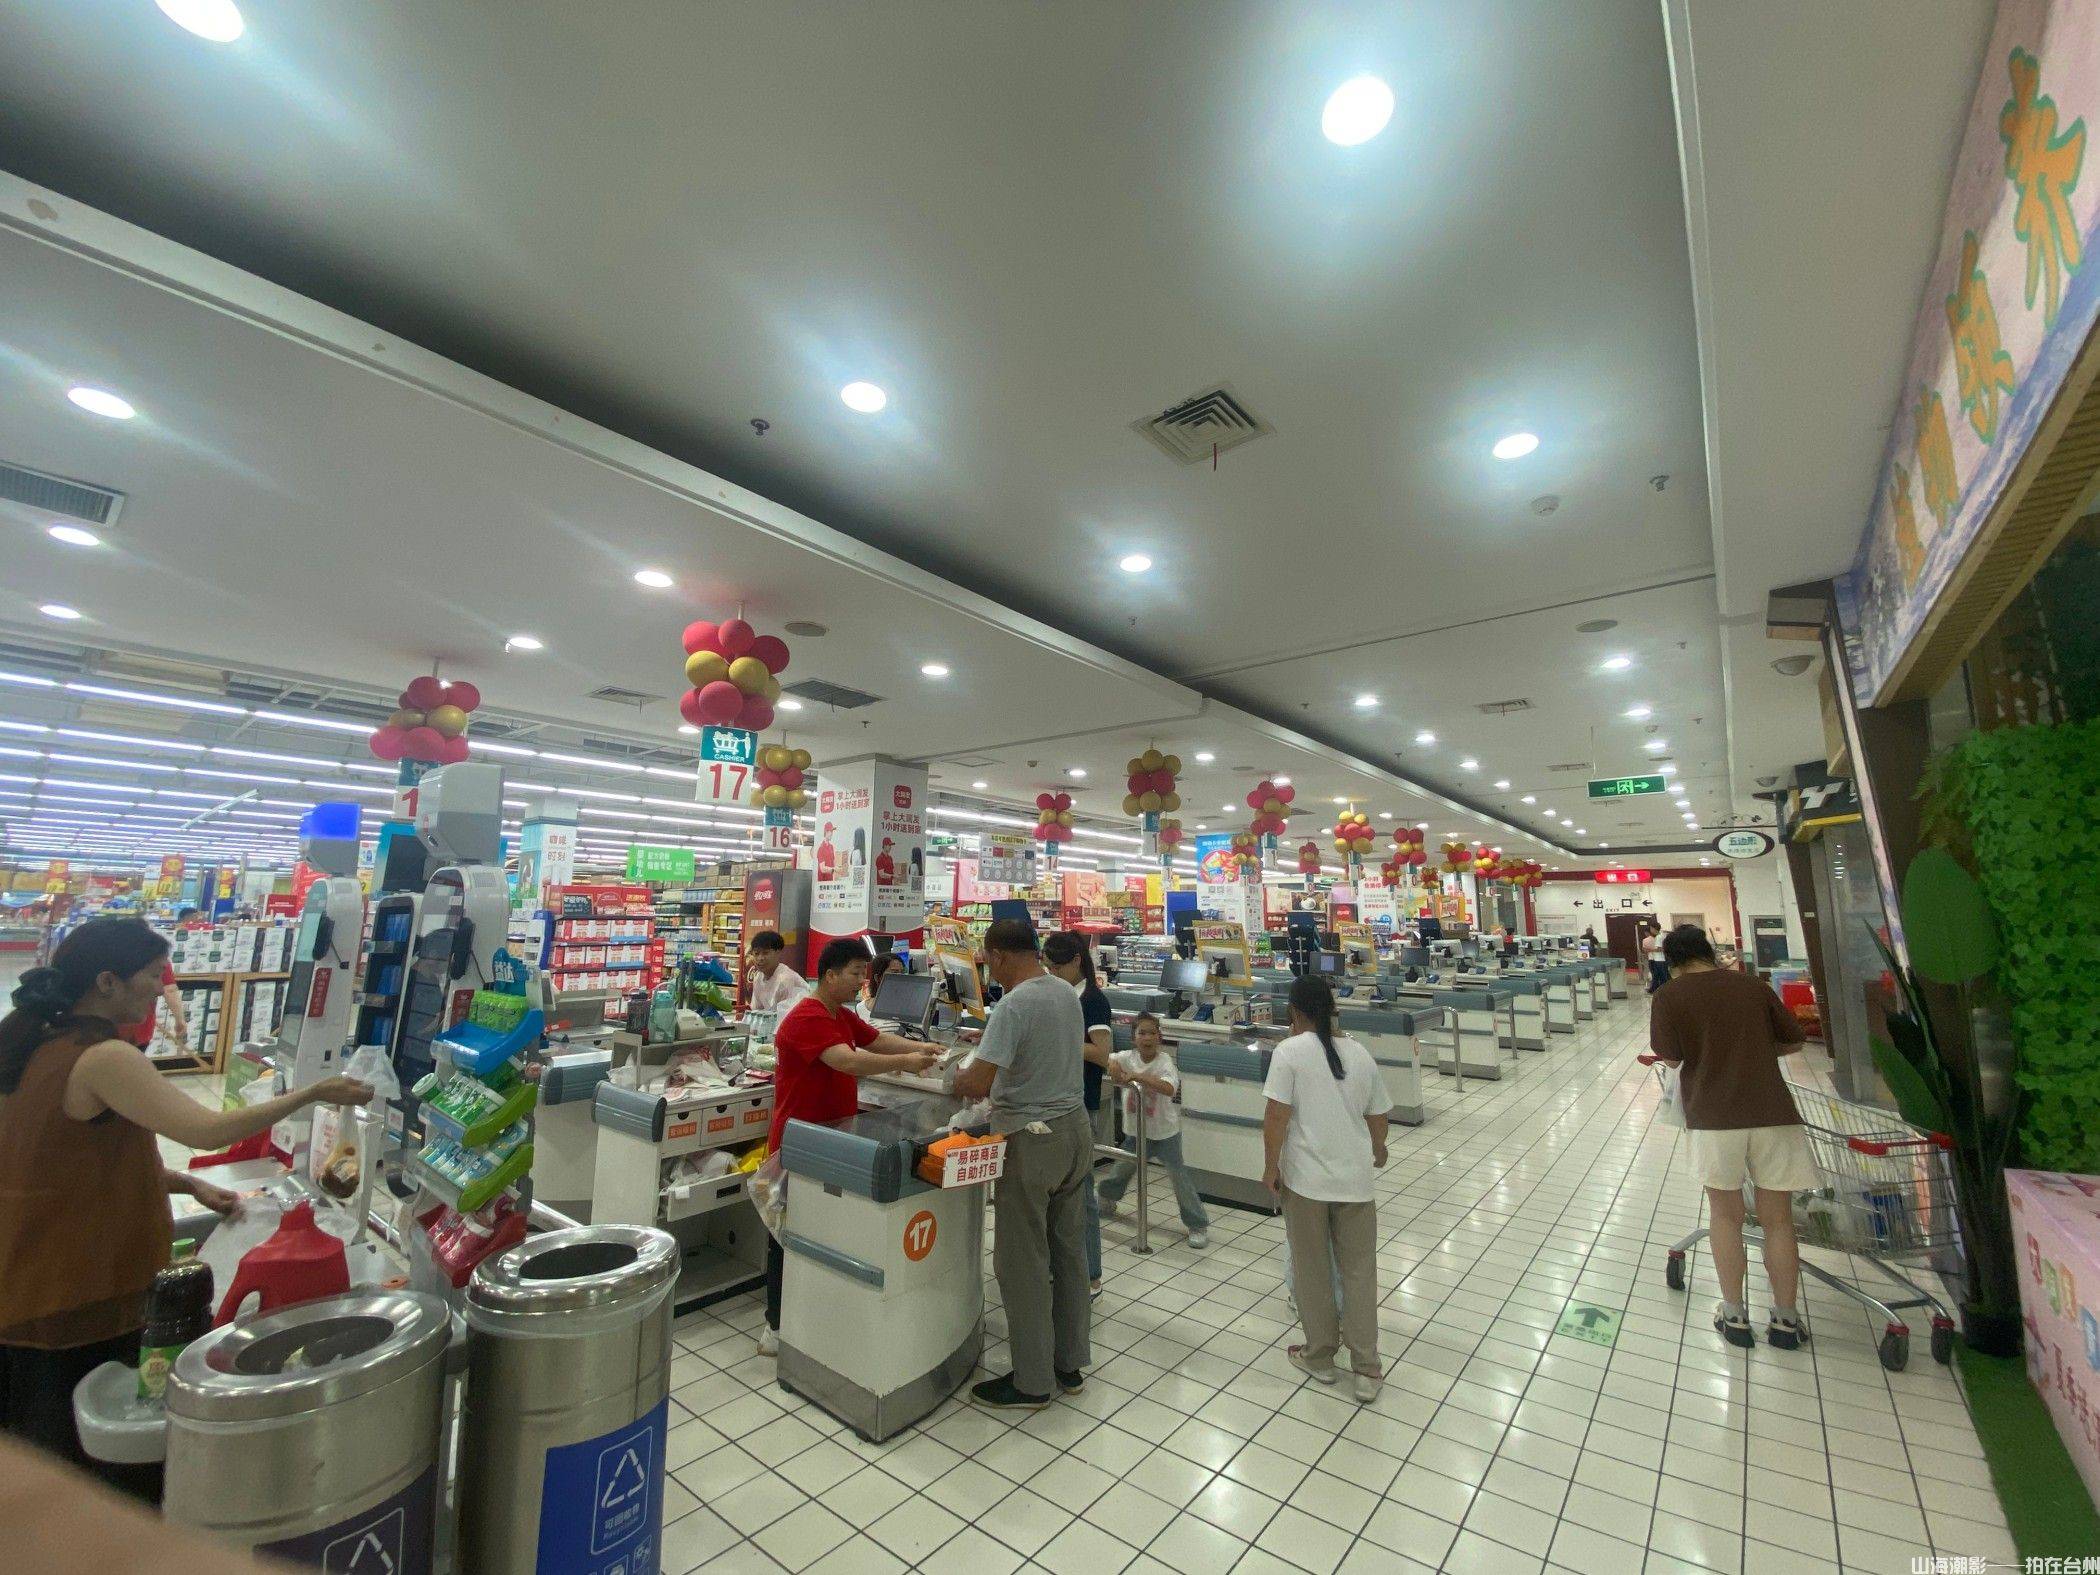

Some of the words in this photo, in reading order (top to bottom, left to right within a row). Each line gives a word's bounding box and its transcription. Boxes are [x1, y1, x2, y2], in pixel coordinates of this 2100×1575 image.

[714, 753, 745, 763] CASHIER
[709, 763, 748, 800] 17
[402, 788, 419, 817] 1
[770, 827, 790, 847] 16
[1593, 899, 1633, 909] 出口
[958, 1145, 999, 1165] 易碎商品
[956, 1162, 998, 1182] 自助打包
[909, 1218, 933, 1252] 17
